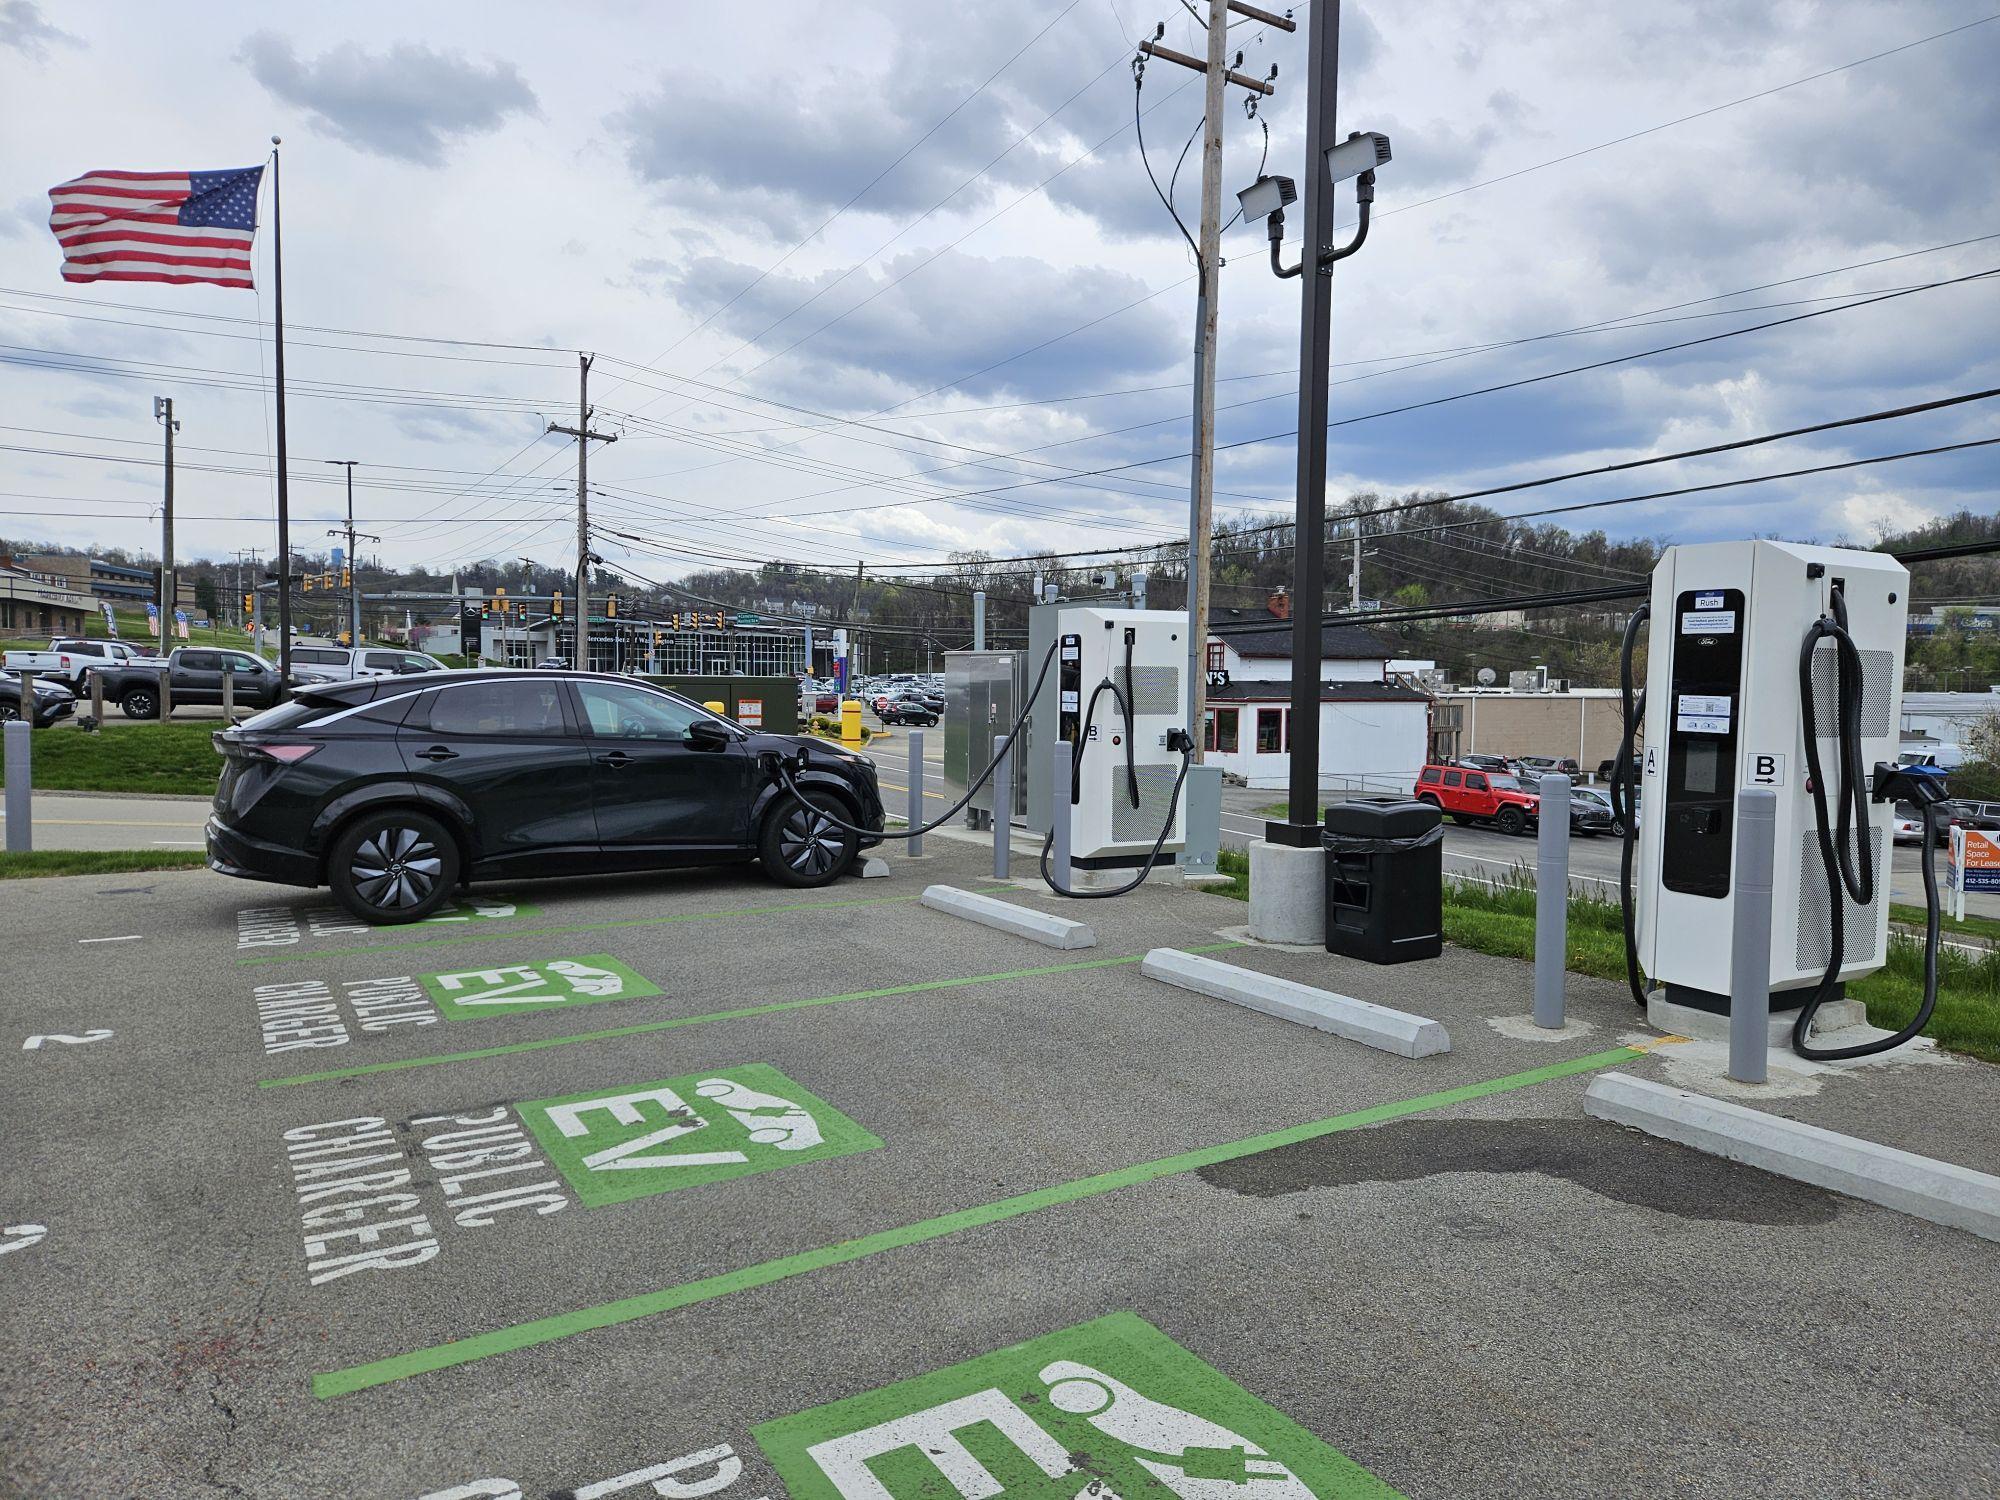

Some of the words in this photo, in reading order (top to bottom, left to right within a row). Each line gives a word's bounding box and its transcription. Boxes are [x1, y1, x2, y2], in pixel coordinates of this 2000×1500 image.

[1701, 598, 1719, 606] Rush
[1206, 671, 1225, 685] N'S
[1090, 725, 1097, 736] B
[1648, 749, 1655, 767] A
[1756, 755, 1775, 775] B
[1966, 850, 1990, 859] Space
[1967, 841, 1988, 849] Retail
[436, 965, 567, 1006] EV
[342, 976, 438, 1031] PUBLIC
[253, 980, 350, 1055] CHARGER
[23, 1029, 115, 1050] 2
[544, 1087, 749, 1171] EV
[411, 1106, 569, 1228] PUBLIC
[283, 1116, 441, 1286] CHARGER
